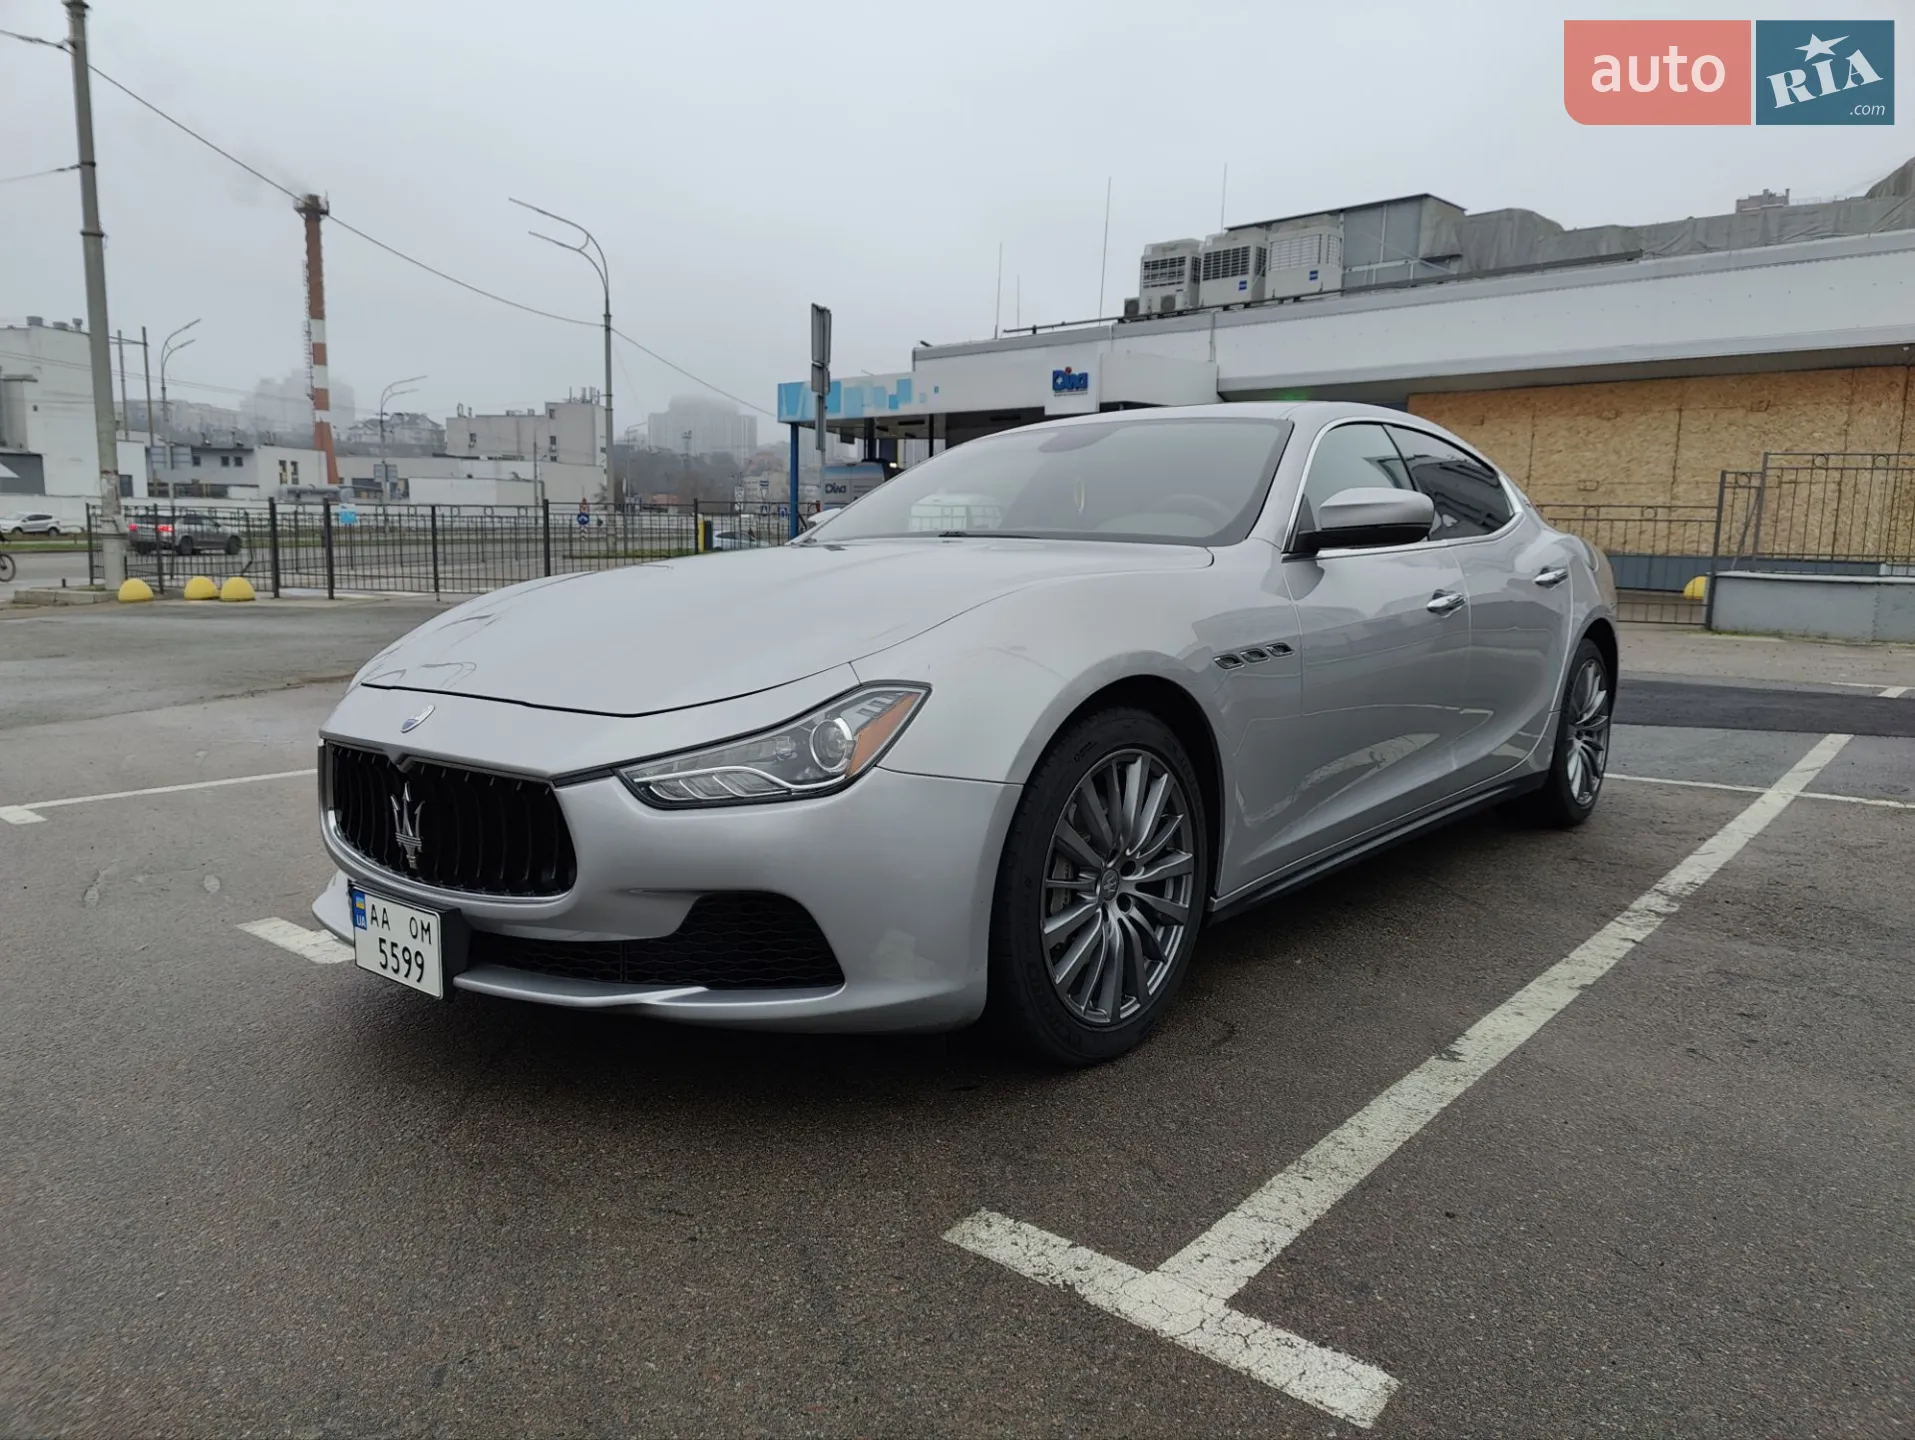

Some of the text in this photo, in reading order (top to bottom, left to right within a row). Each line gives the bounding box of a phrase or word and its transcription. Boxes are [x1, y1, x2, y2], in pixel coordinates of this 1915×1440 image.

[356, 913, 367, 928] UA
[370, 904, 432, 945] AA OM
[378, 937, 424, 982] 5599
